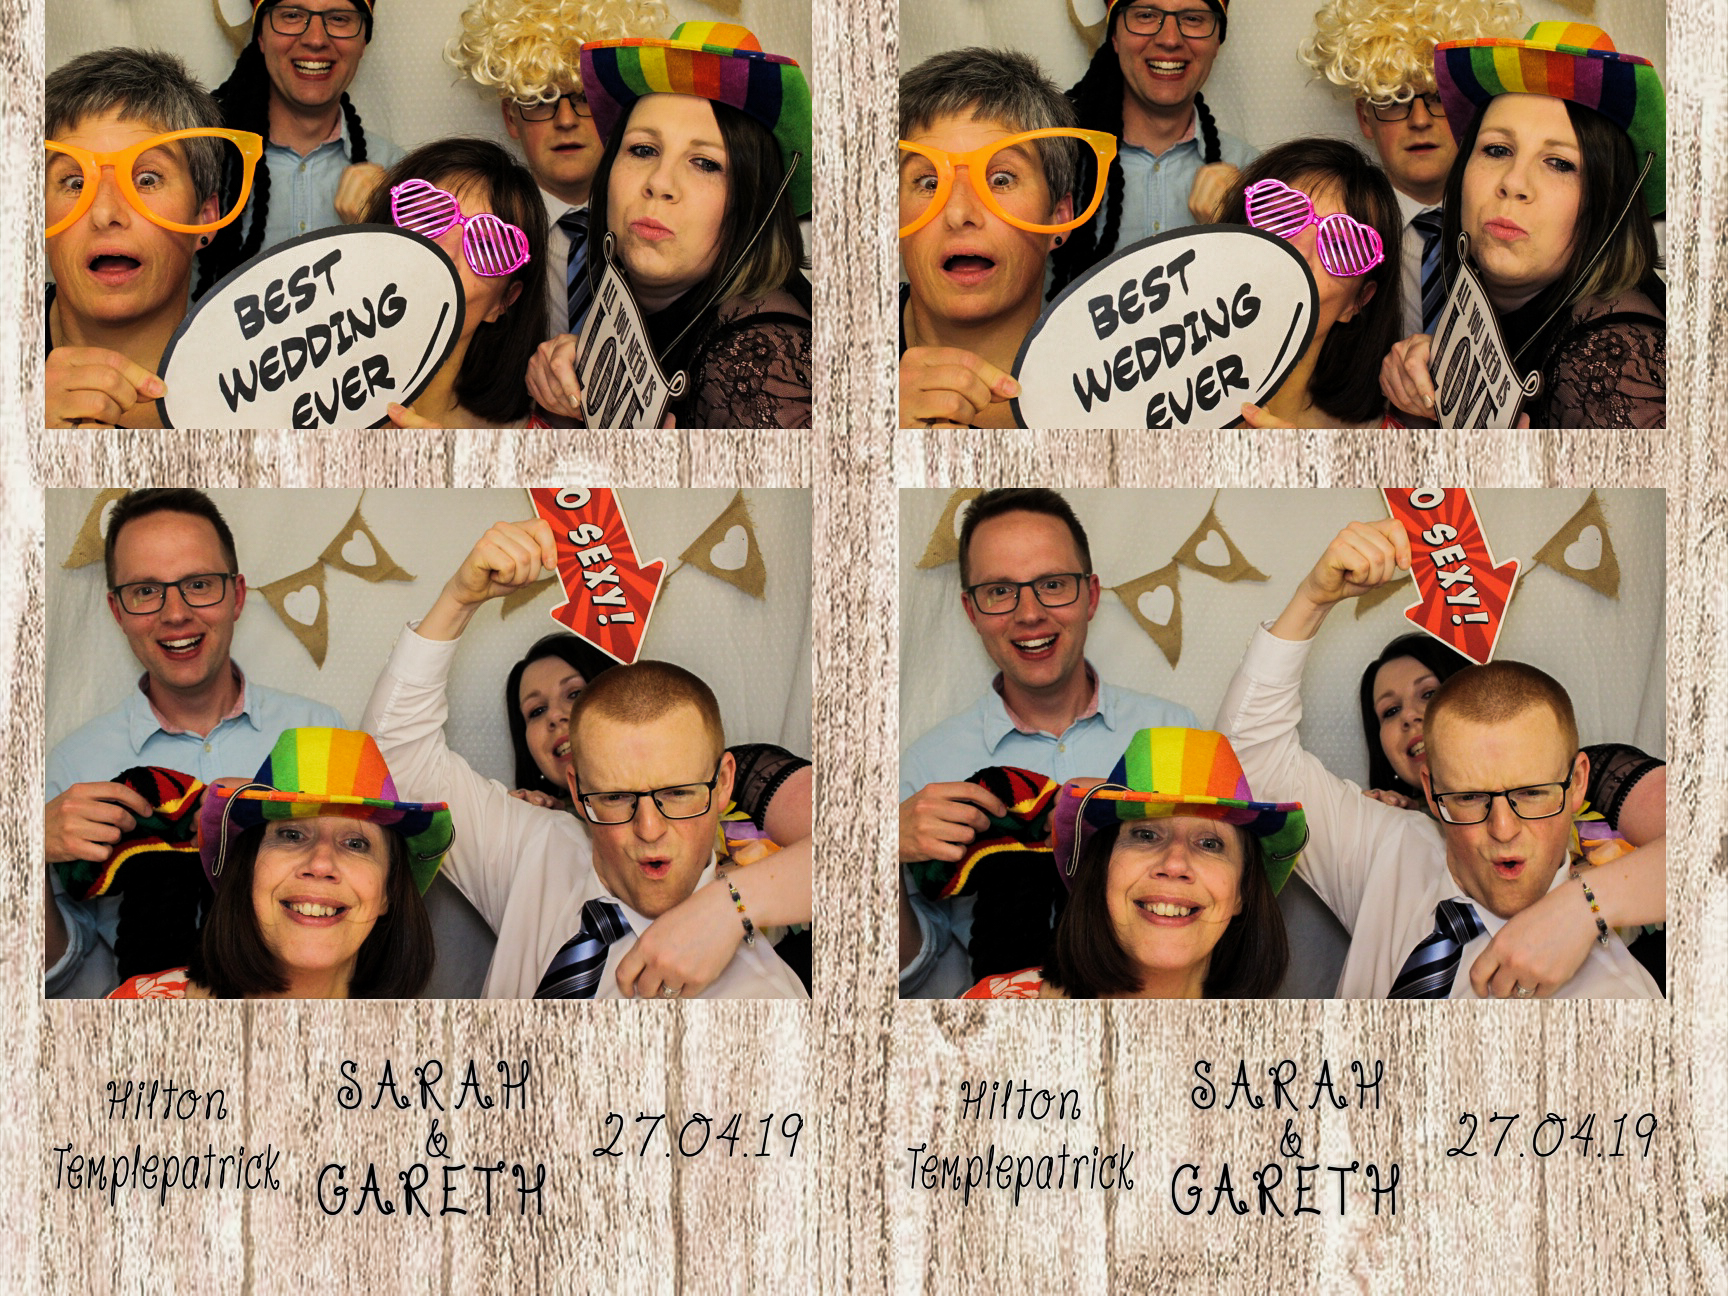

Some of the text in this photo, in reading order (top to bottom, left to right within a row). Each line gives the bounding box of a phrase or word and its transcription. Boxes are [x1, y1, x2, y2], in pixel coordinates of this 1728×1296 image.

[219, 283, 407, 413] WEDDING
[234, 249, 342, 340] BEST
[602, 278, 657, 407] ALL YOU NEED IS
[1073, 283, 1261, 413] WEDDING
[1088, 249, 1196, 340] BEST
[1456, 278, 1511, 407] ALL YOU NEED IS
[292, 354, 396, 429] EVER
[1146, 354, 1250, 429] EVER
[555, 488, 636, 626] O SEXY!
[1409, 488, 1490, 626] O SEXY!
